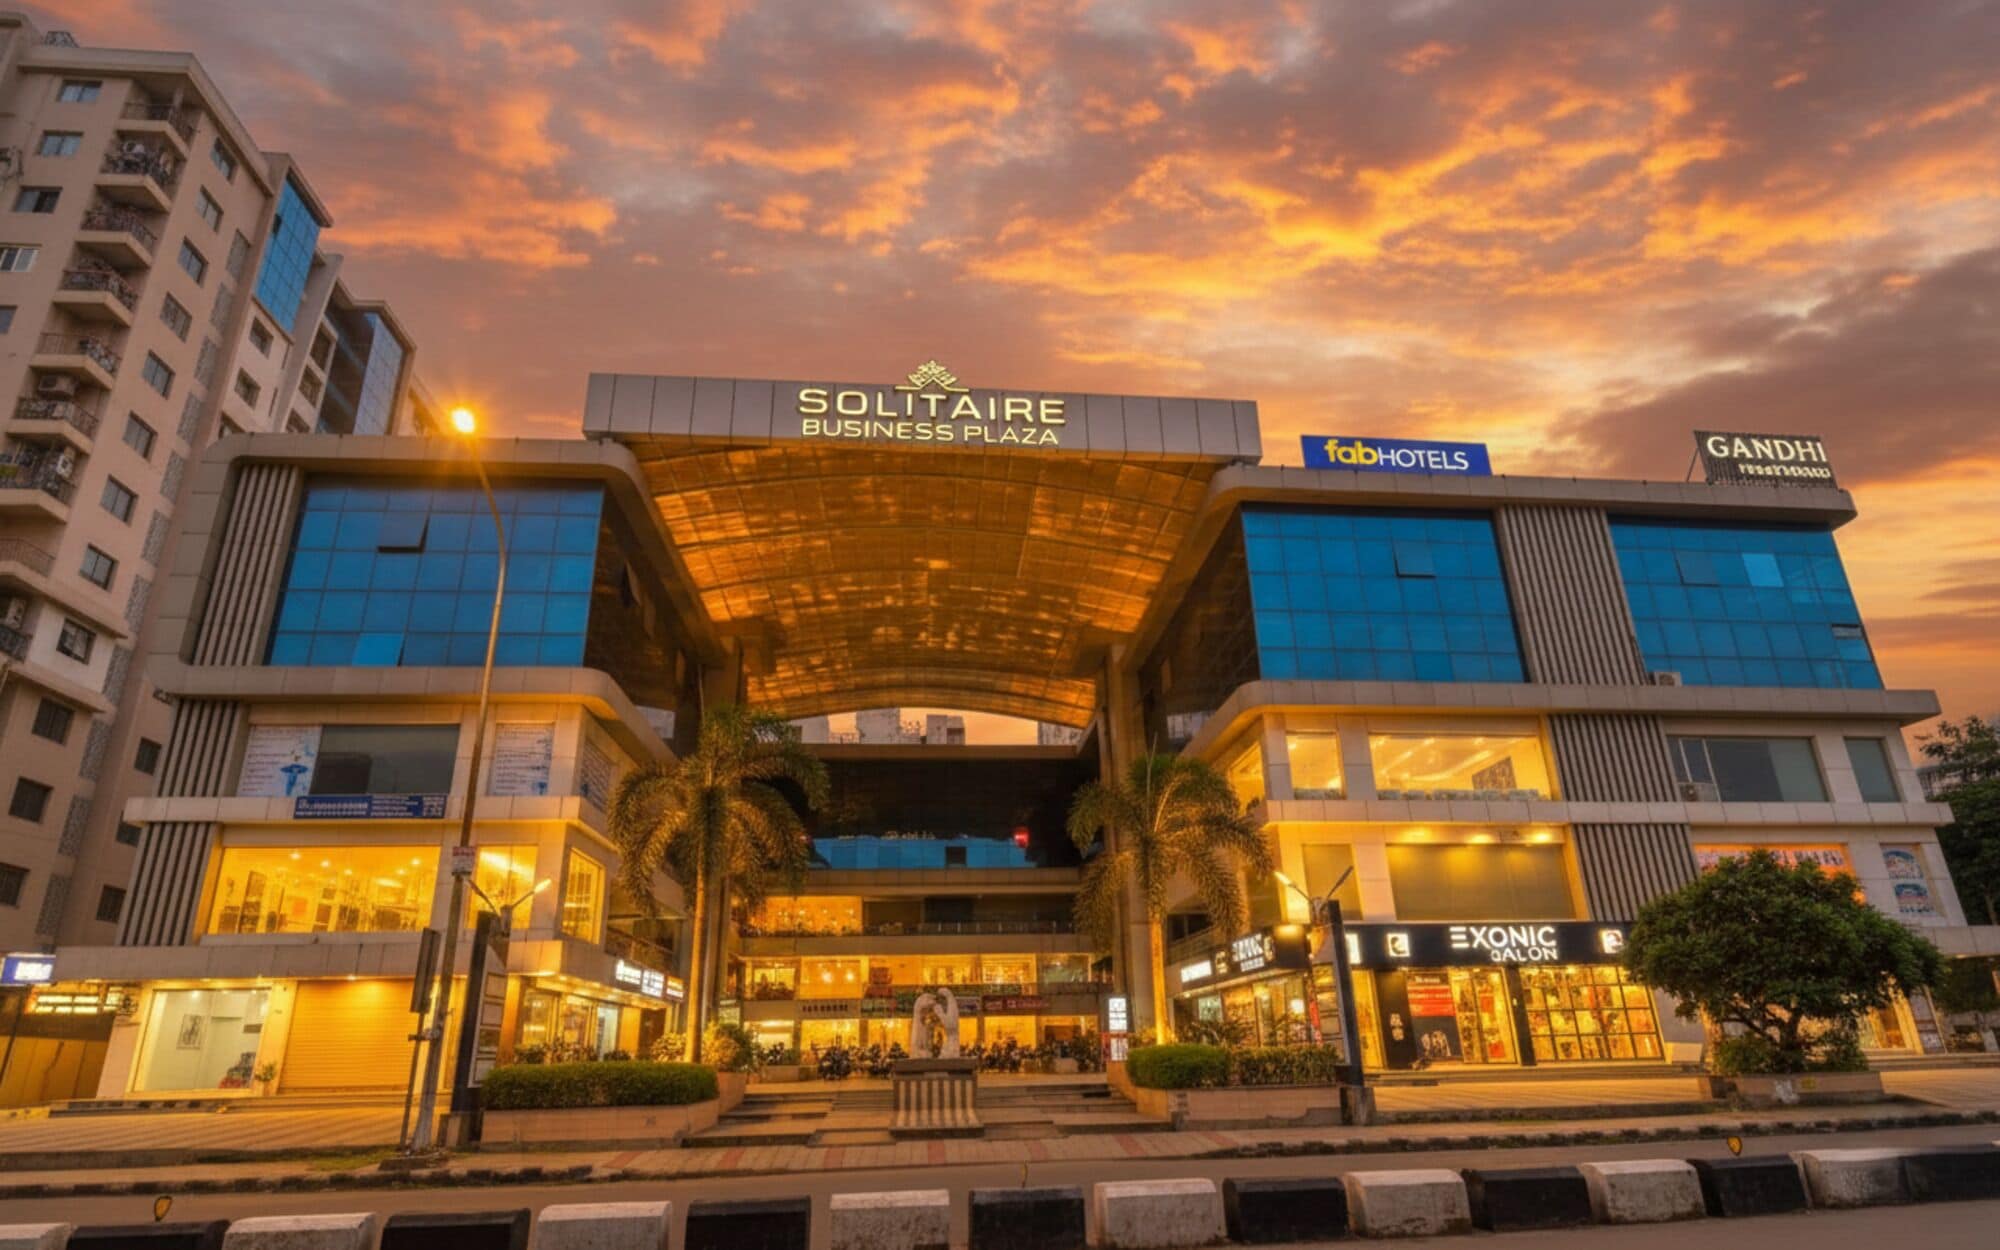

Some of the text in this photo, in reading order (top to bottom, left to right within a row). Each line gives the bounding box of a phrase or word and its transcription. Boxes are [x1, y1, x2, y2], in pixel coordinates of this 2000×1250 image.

[798, 388, 1066, 425] SOLITAIRE
[801, 418, 1060, 446] BUSINESS PLAZA
[1706, 436, 1828, 463] GANDHI
[1449, 925, 1557, 949] EXONIC
